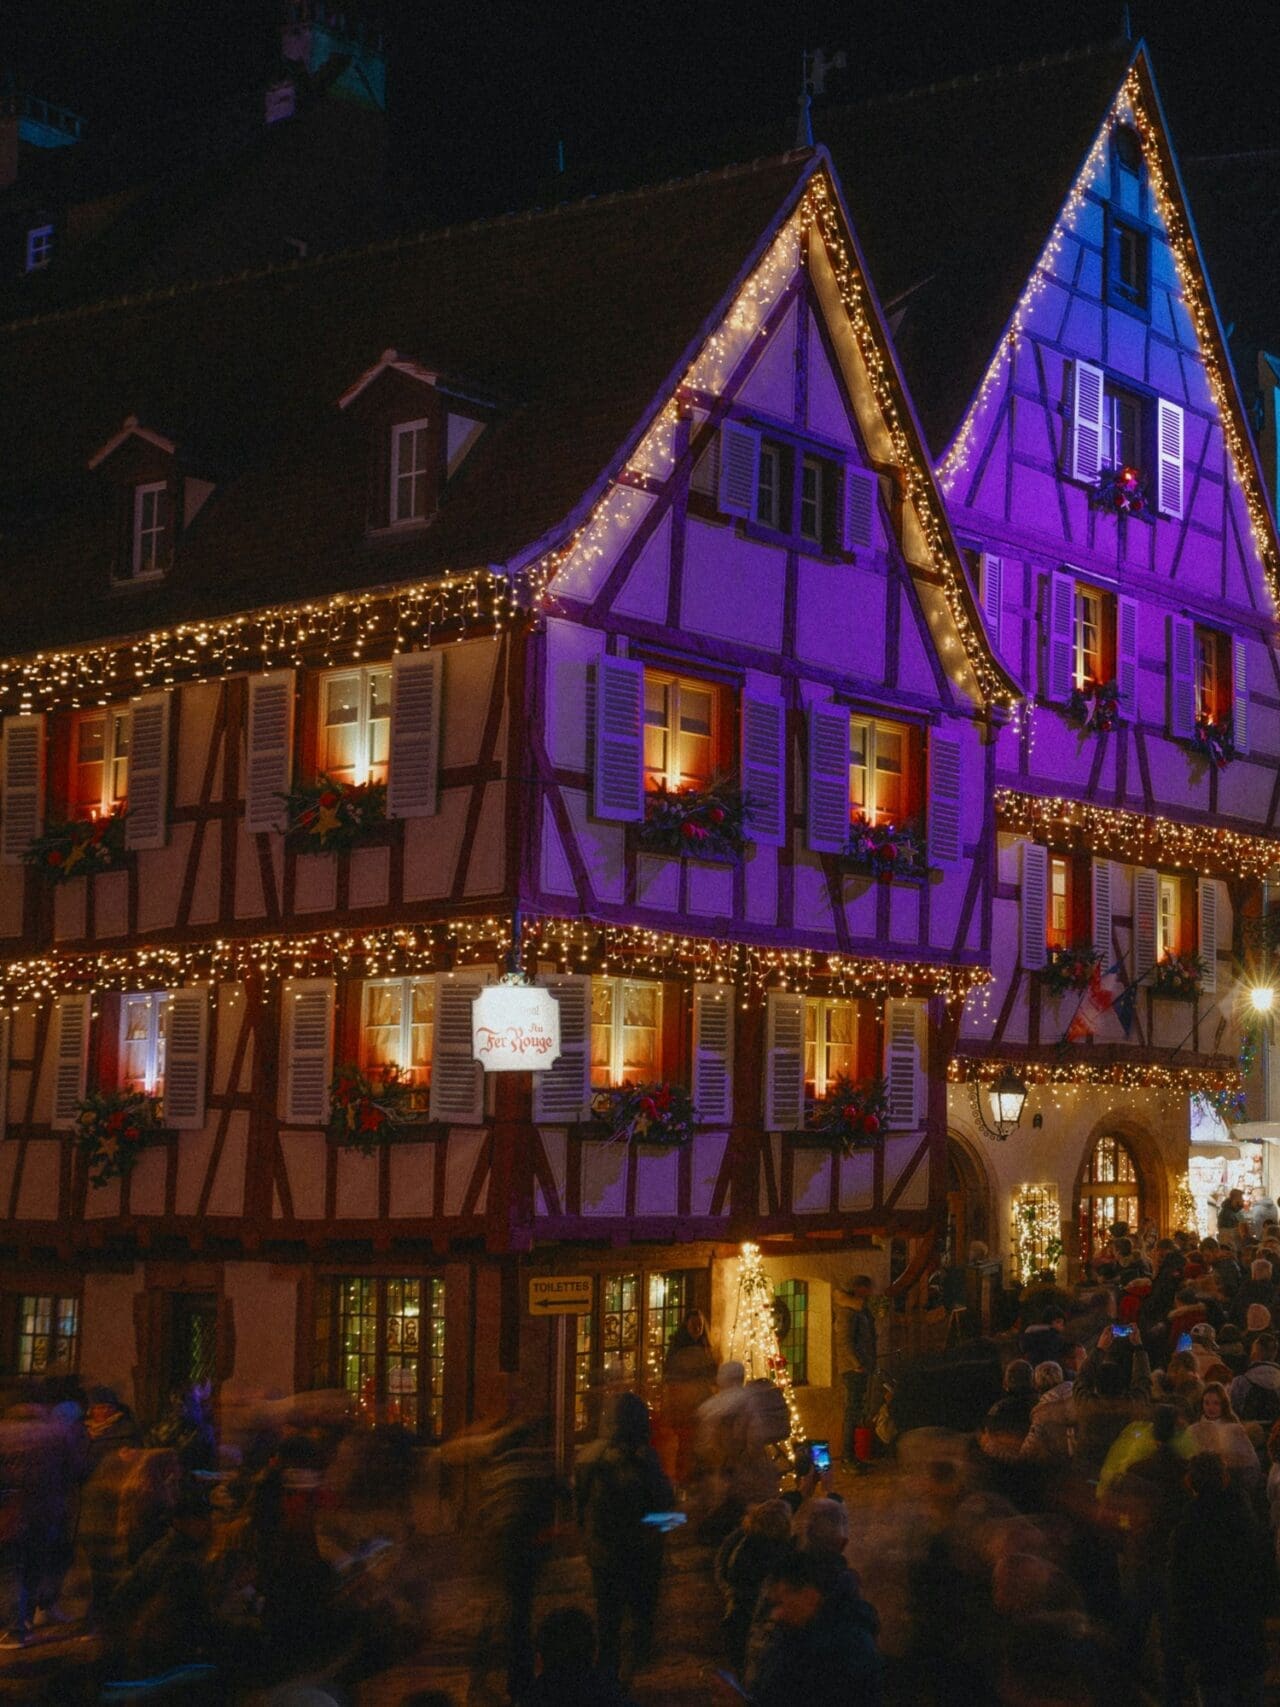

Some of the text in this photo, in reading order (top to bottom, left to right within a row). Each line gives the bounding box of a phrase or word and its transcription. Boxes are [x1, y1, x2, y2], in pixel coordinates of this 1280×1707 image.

[475, 1026, 553, 1055] Fer Rouge
[533, 1281, 590, 1293] TOILETTES
